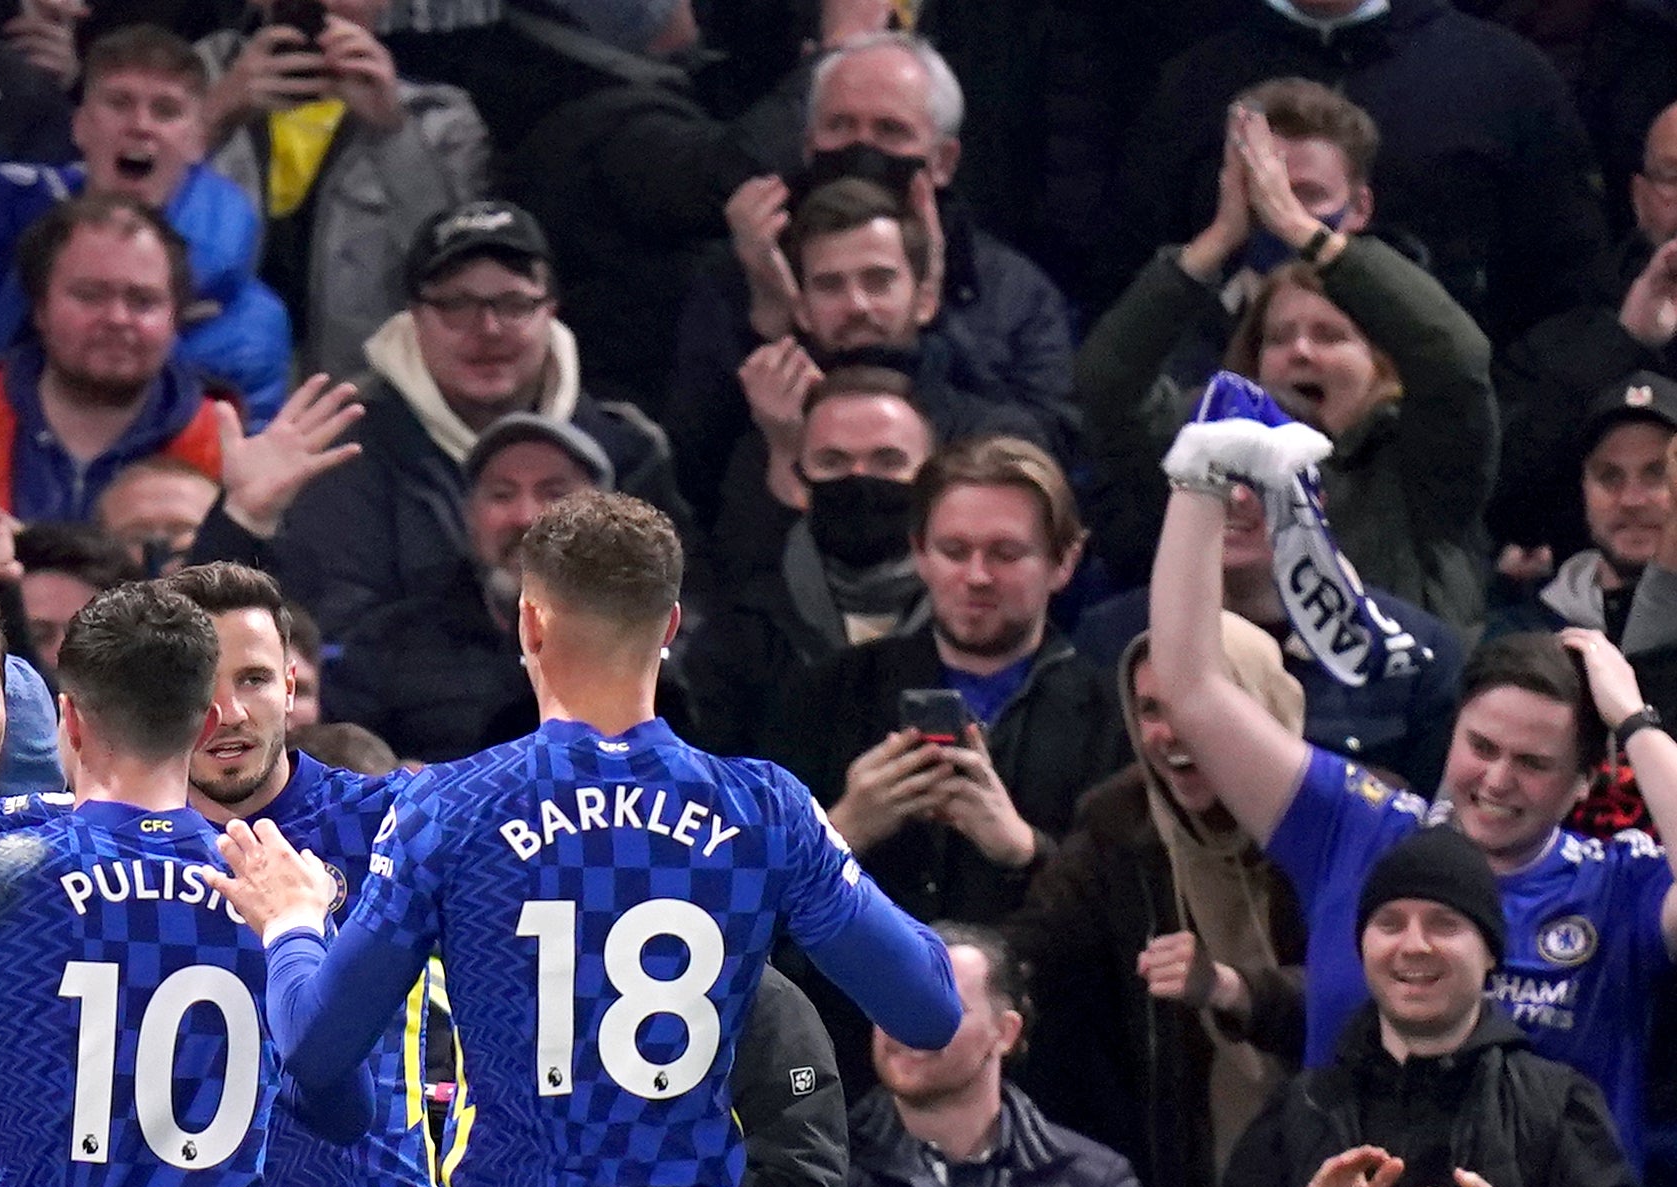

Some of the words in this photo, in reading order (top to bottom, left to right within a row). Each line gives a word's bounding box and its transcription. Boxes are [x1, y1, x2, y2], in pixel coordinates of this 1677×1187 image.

[140, 819, 173, 833] CFC
[498, 784, 741, 862] BARKLEY
[57, 961, 262, 1170] 10
[515, 898, 726, 1100] 18
